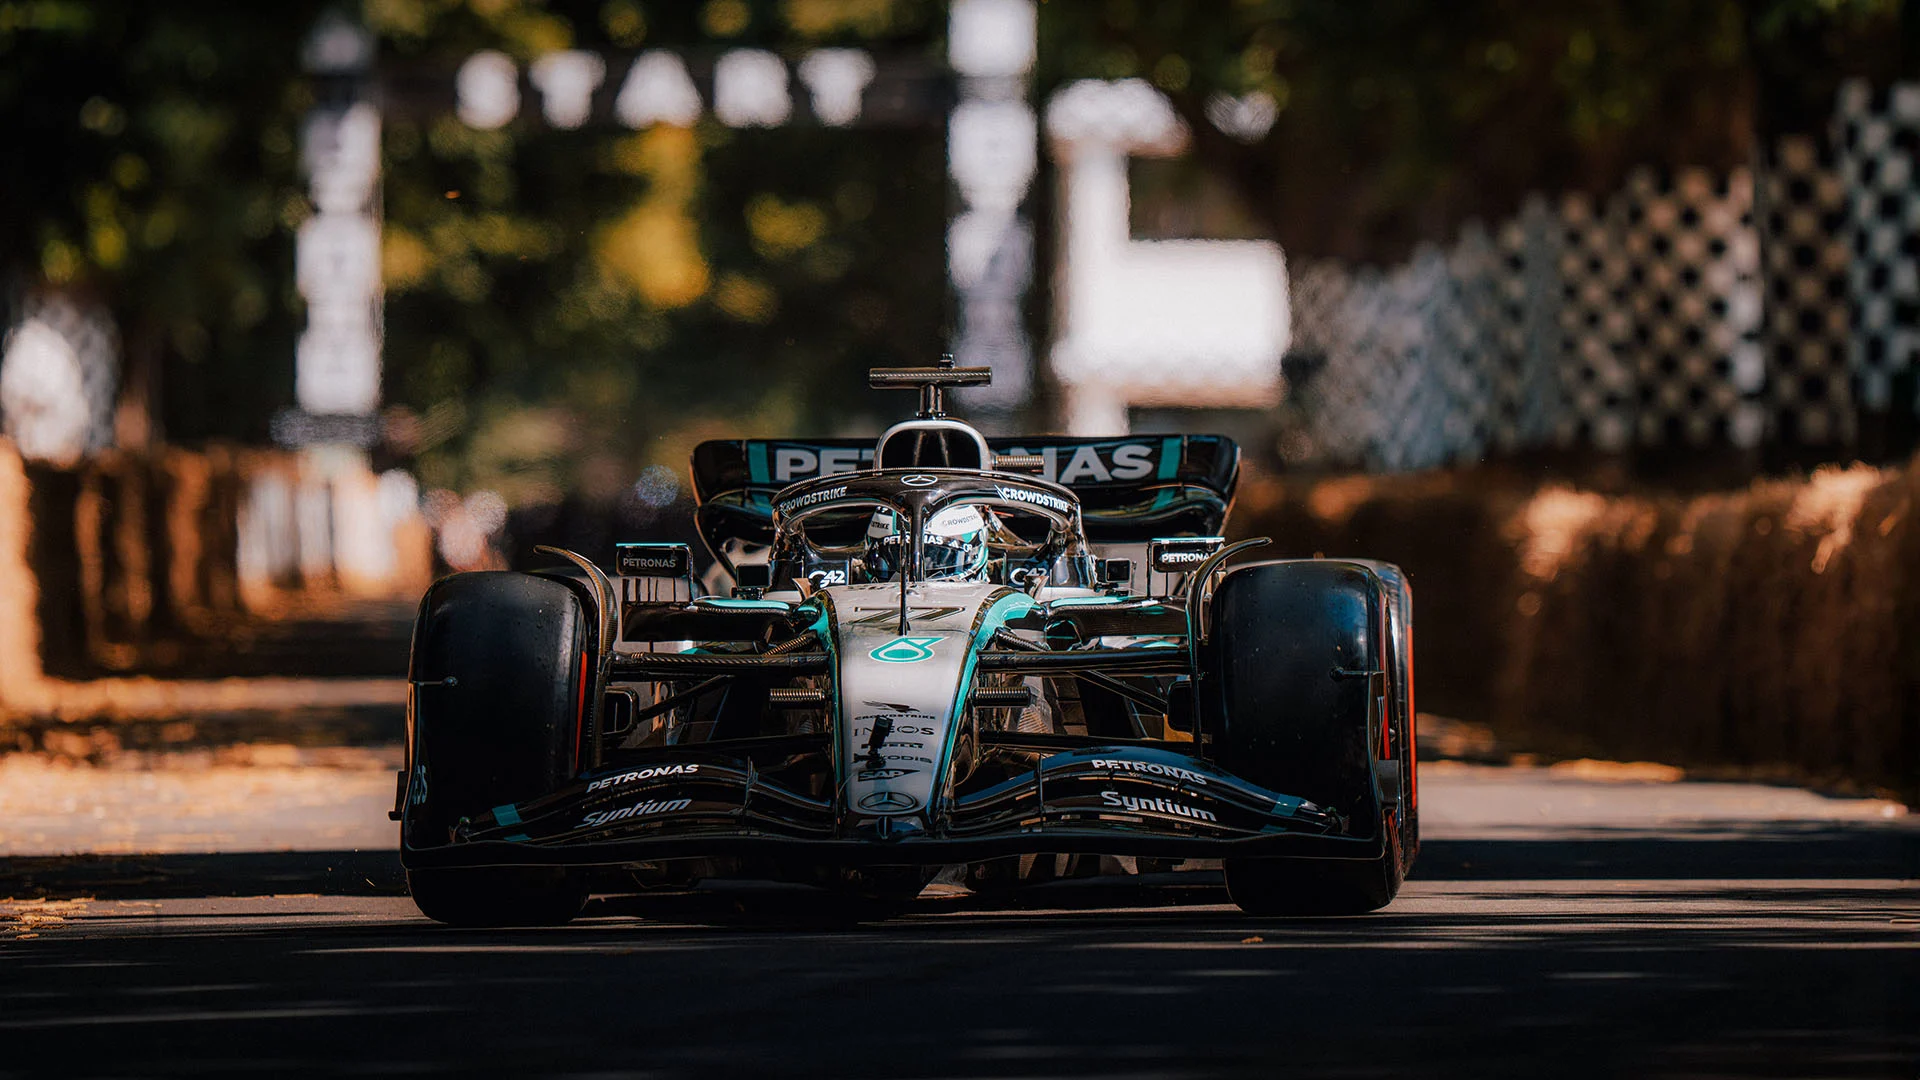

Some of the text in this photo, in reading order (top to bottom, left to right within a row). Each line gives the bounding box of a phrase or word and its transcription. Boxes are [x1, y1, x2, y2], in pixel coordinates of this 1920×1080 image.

[455, 47, 877, 130] START
[775, 444, 1154, 484] PENAS
[1003, 487, 1068, 512] CROWDSTRIKE
[883, 534, 944, 546] PETRAS
[622, 557, 677, 568] PETRONAS
[1161, 552, 1217, 563] PETRONA
[853, 753, 933, 764] ODIS
[585, 763, 700, 794] PETRONAS
[858, 769, 906, 780] SAP
[1091, 759, 1208, 785] PETRONAS
[574, 798, 692, 829] Syntium
[1100, 790, 1217, 822] Syntium
